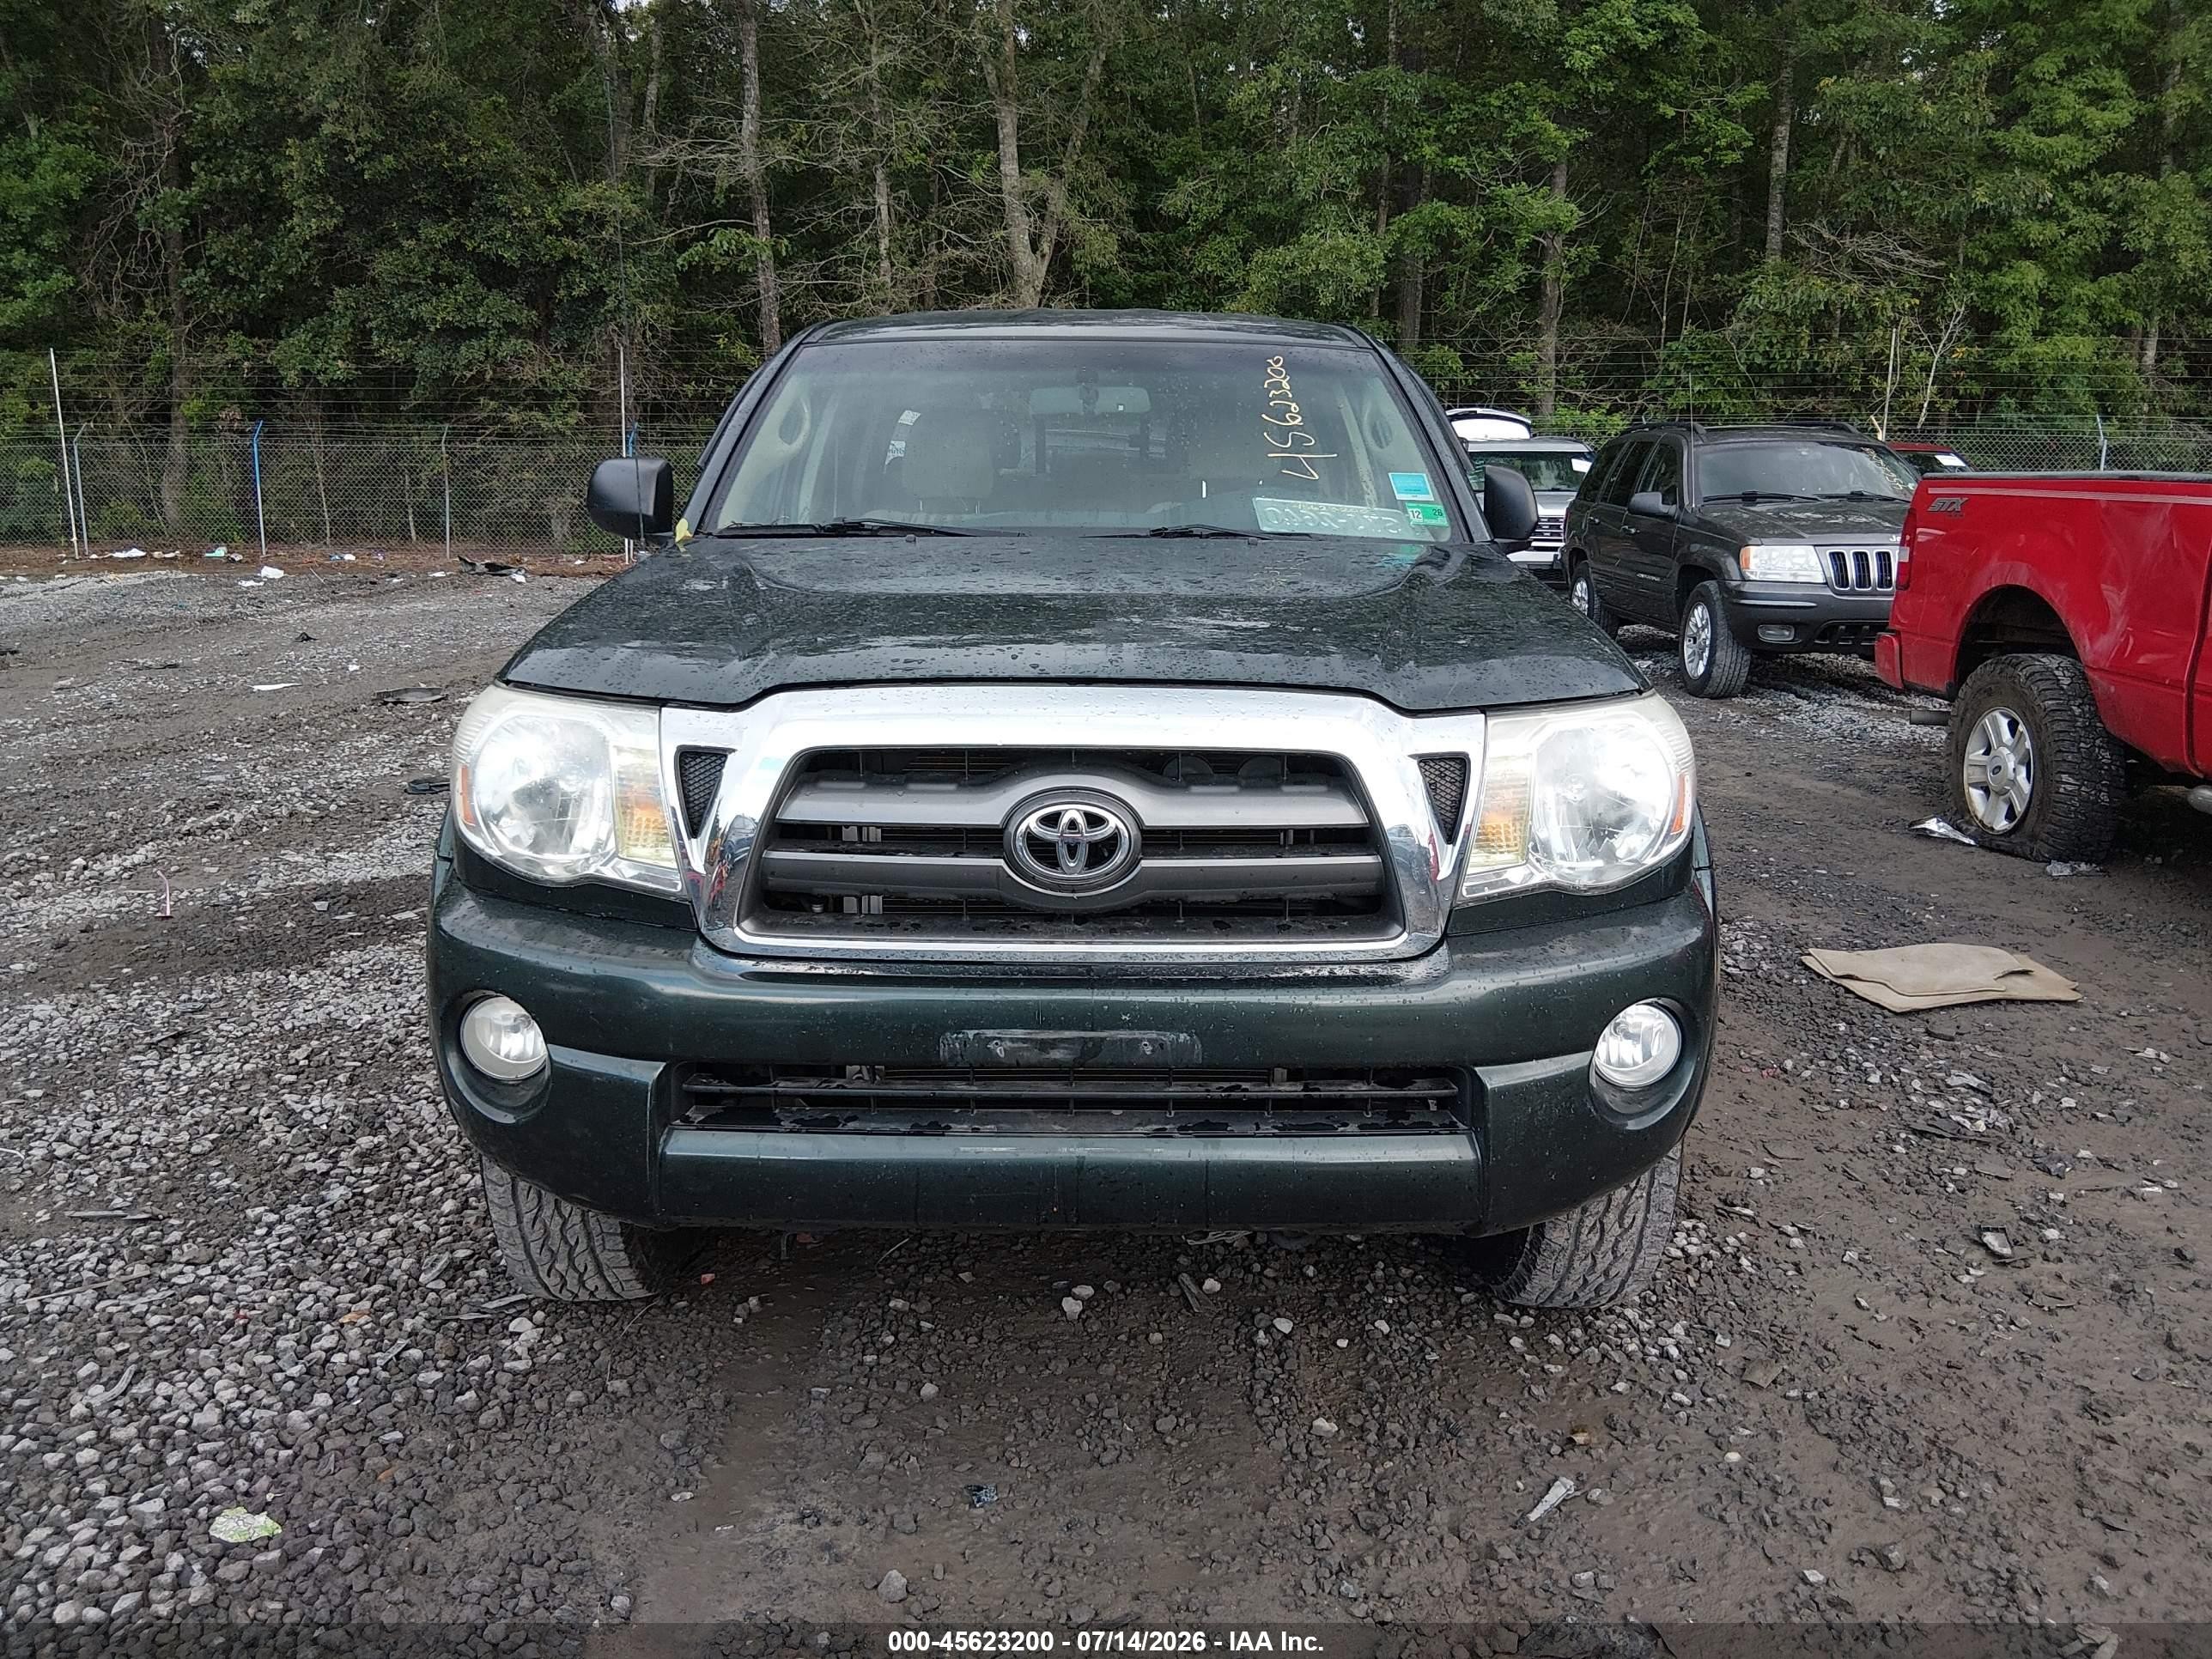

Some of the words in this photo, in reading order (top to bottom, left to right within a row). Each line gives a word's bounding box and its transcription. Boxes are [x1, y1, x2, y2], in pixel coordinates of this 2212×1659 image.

[1261, 356, 1338, 479] 45623200
[1928, 497, 1968, 512] STX
[1410, 510, 1422, 520] 12
